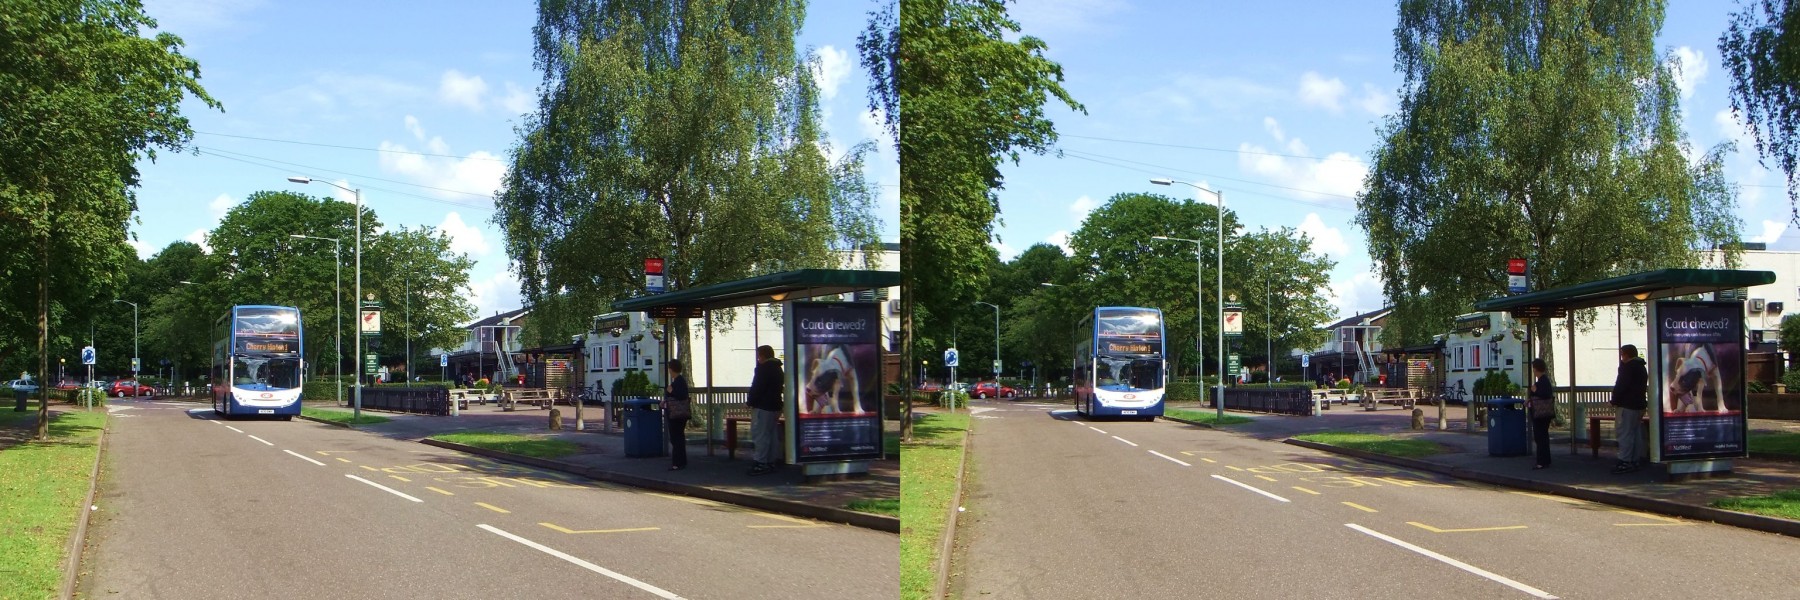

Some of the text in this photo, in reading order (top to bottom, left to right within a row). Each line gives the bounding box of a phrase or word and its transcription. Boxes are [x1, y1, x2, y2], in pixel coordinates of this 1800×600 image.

[801, 317, 866, 330] Card chewed?
[1665, 316, 1729, 329] Card chewed?
[245, 342, 267, 351] Cherry
[1108, 343, 1129, 352] Cherry
